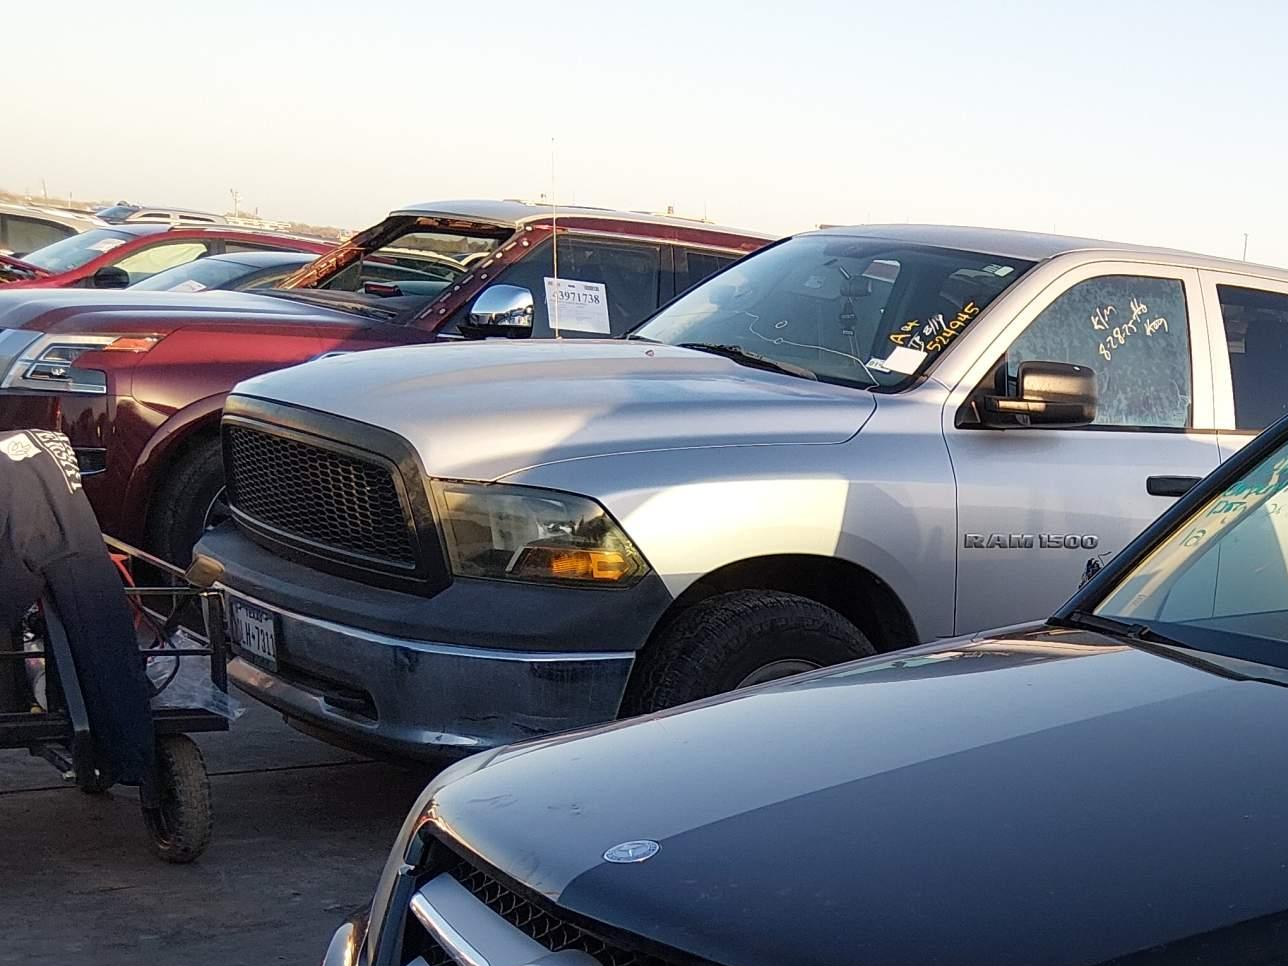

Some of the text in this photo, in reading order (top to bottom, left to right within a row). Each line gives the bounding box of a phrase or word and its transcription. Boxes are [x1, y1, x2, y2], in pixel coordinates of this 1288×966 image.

[926, 302, 980, 351] 524945
[964, 533, 1099, 549] RAM 1500
